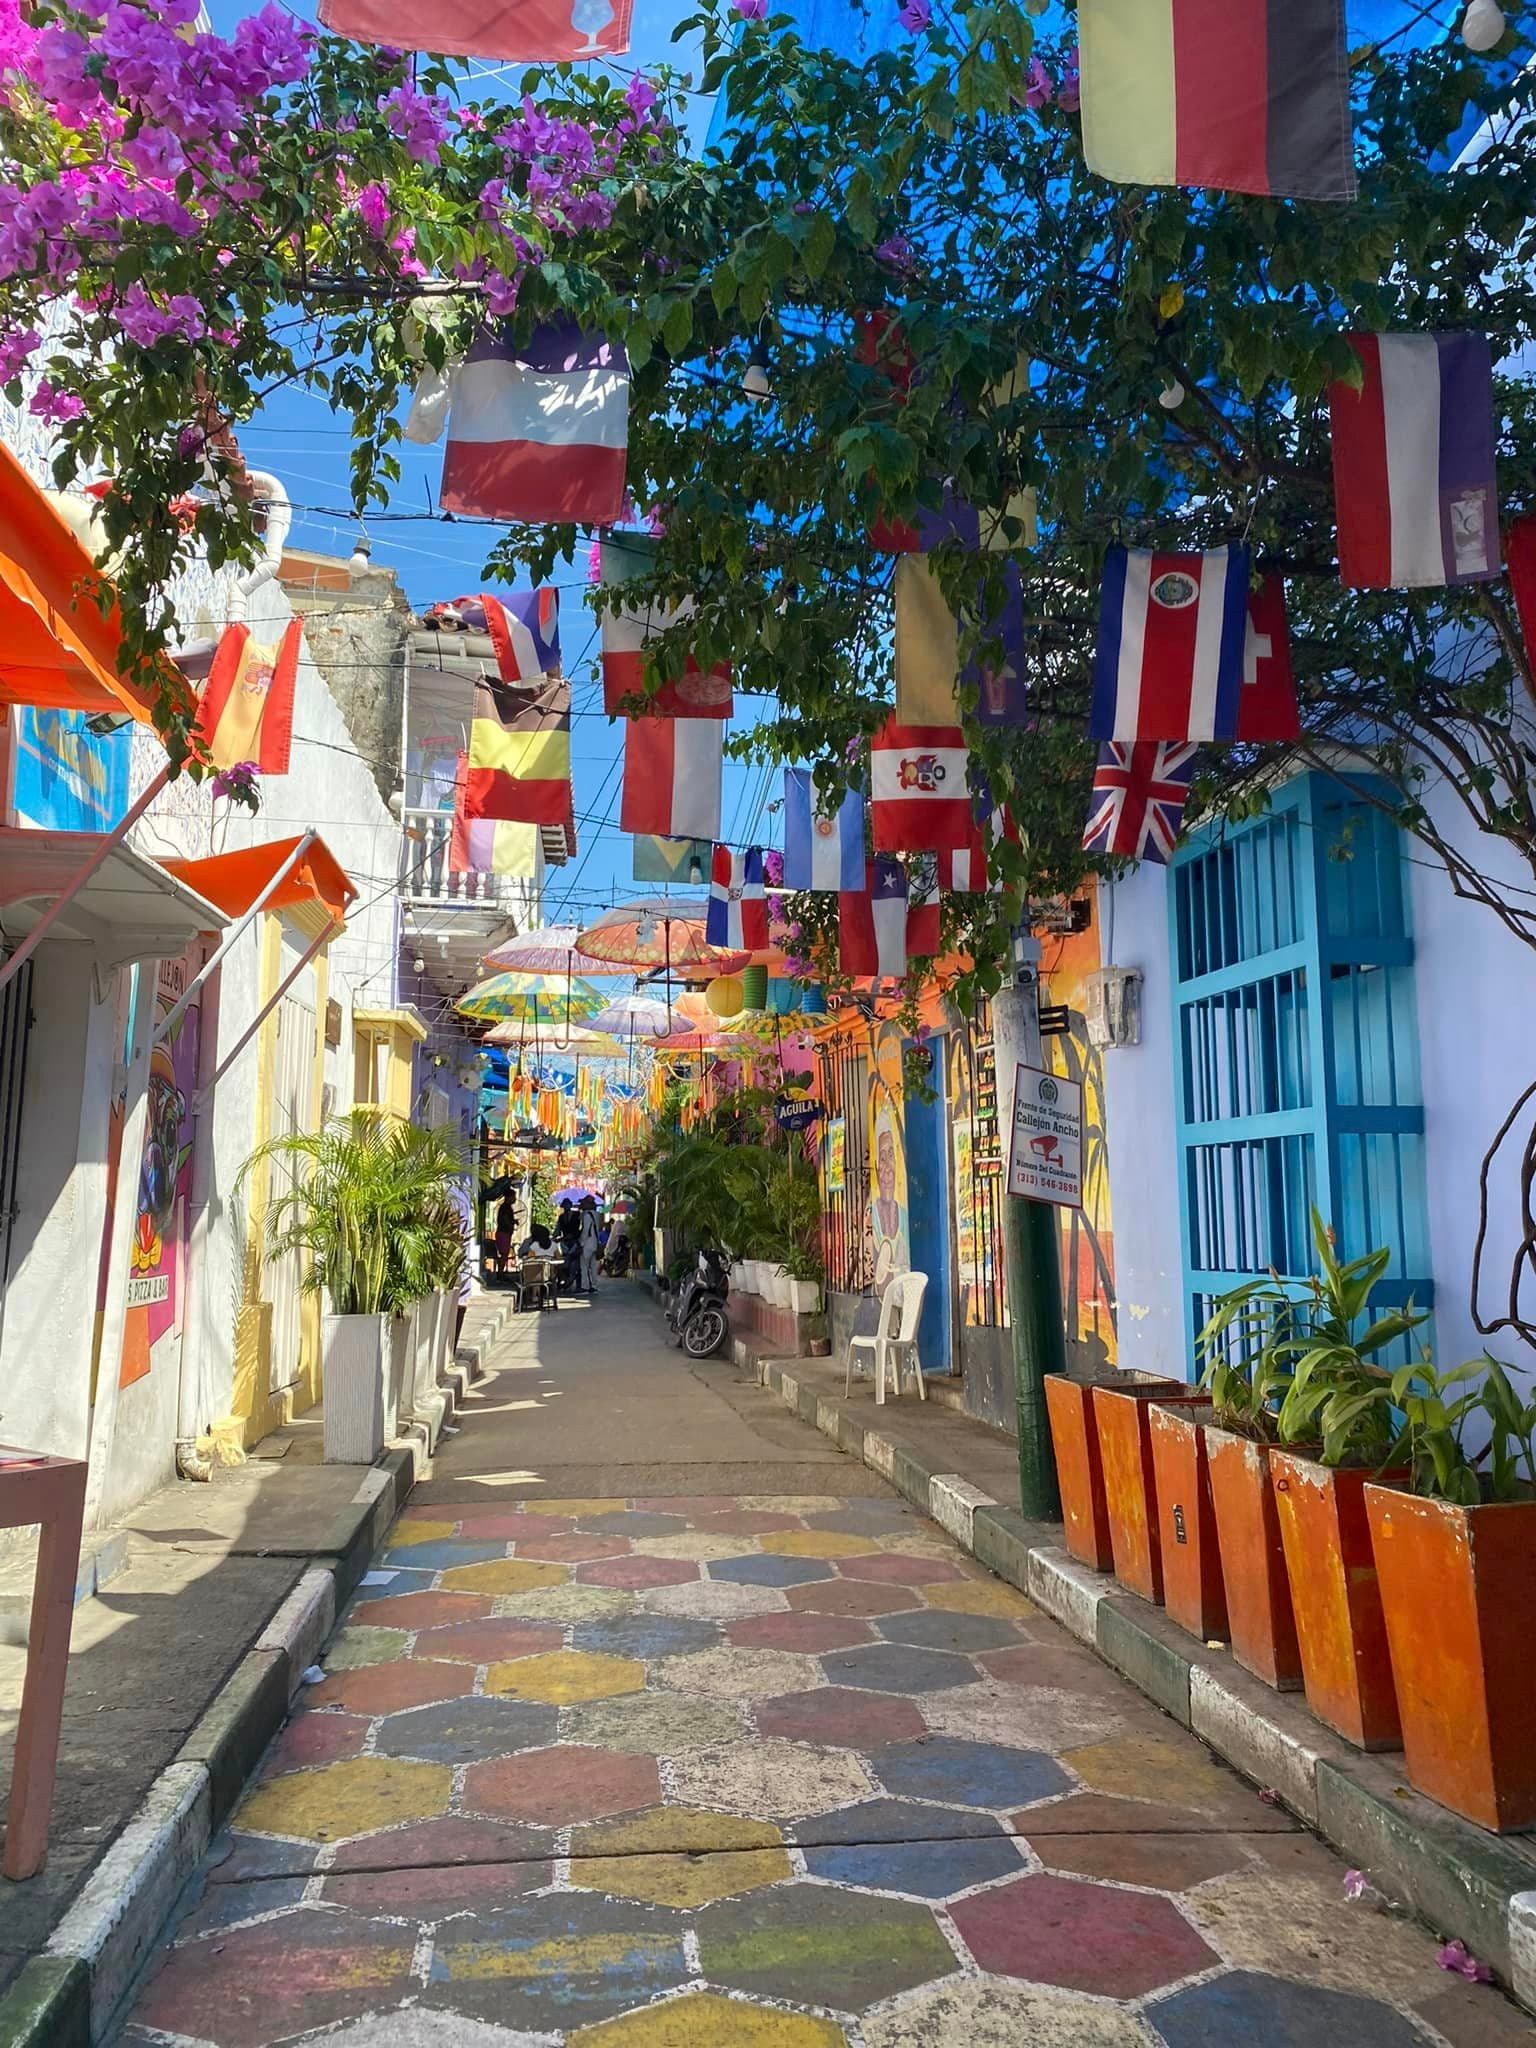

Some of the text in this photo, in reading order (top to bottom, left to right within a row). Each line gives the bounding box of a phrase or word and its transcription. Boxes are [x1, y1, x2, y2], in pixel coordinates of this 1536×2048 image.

[780, 1101, 814, 1119] AGUILA
[1017, 1099, 1080, 1124] Frente de Seguridad
[1052, 1121, 1079, 1138] Ancho
[1017, 1173, 1038, 1187] (313)
[134, 1280, 152, 1301] PIZZA
